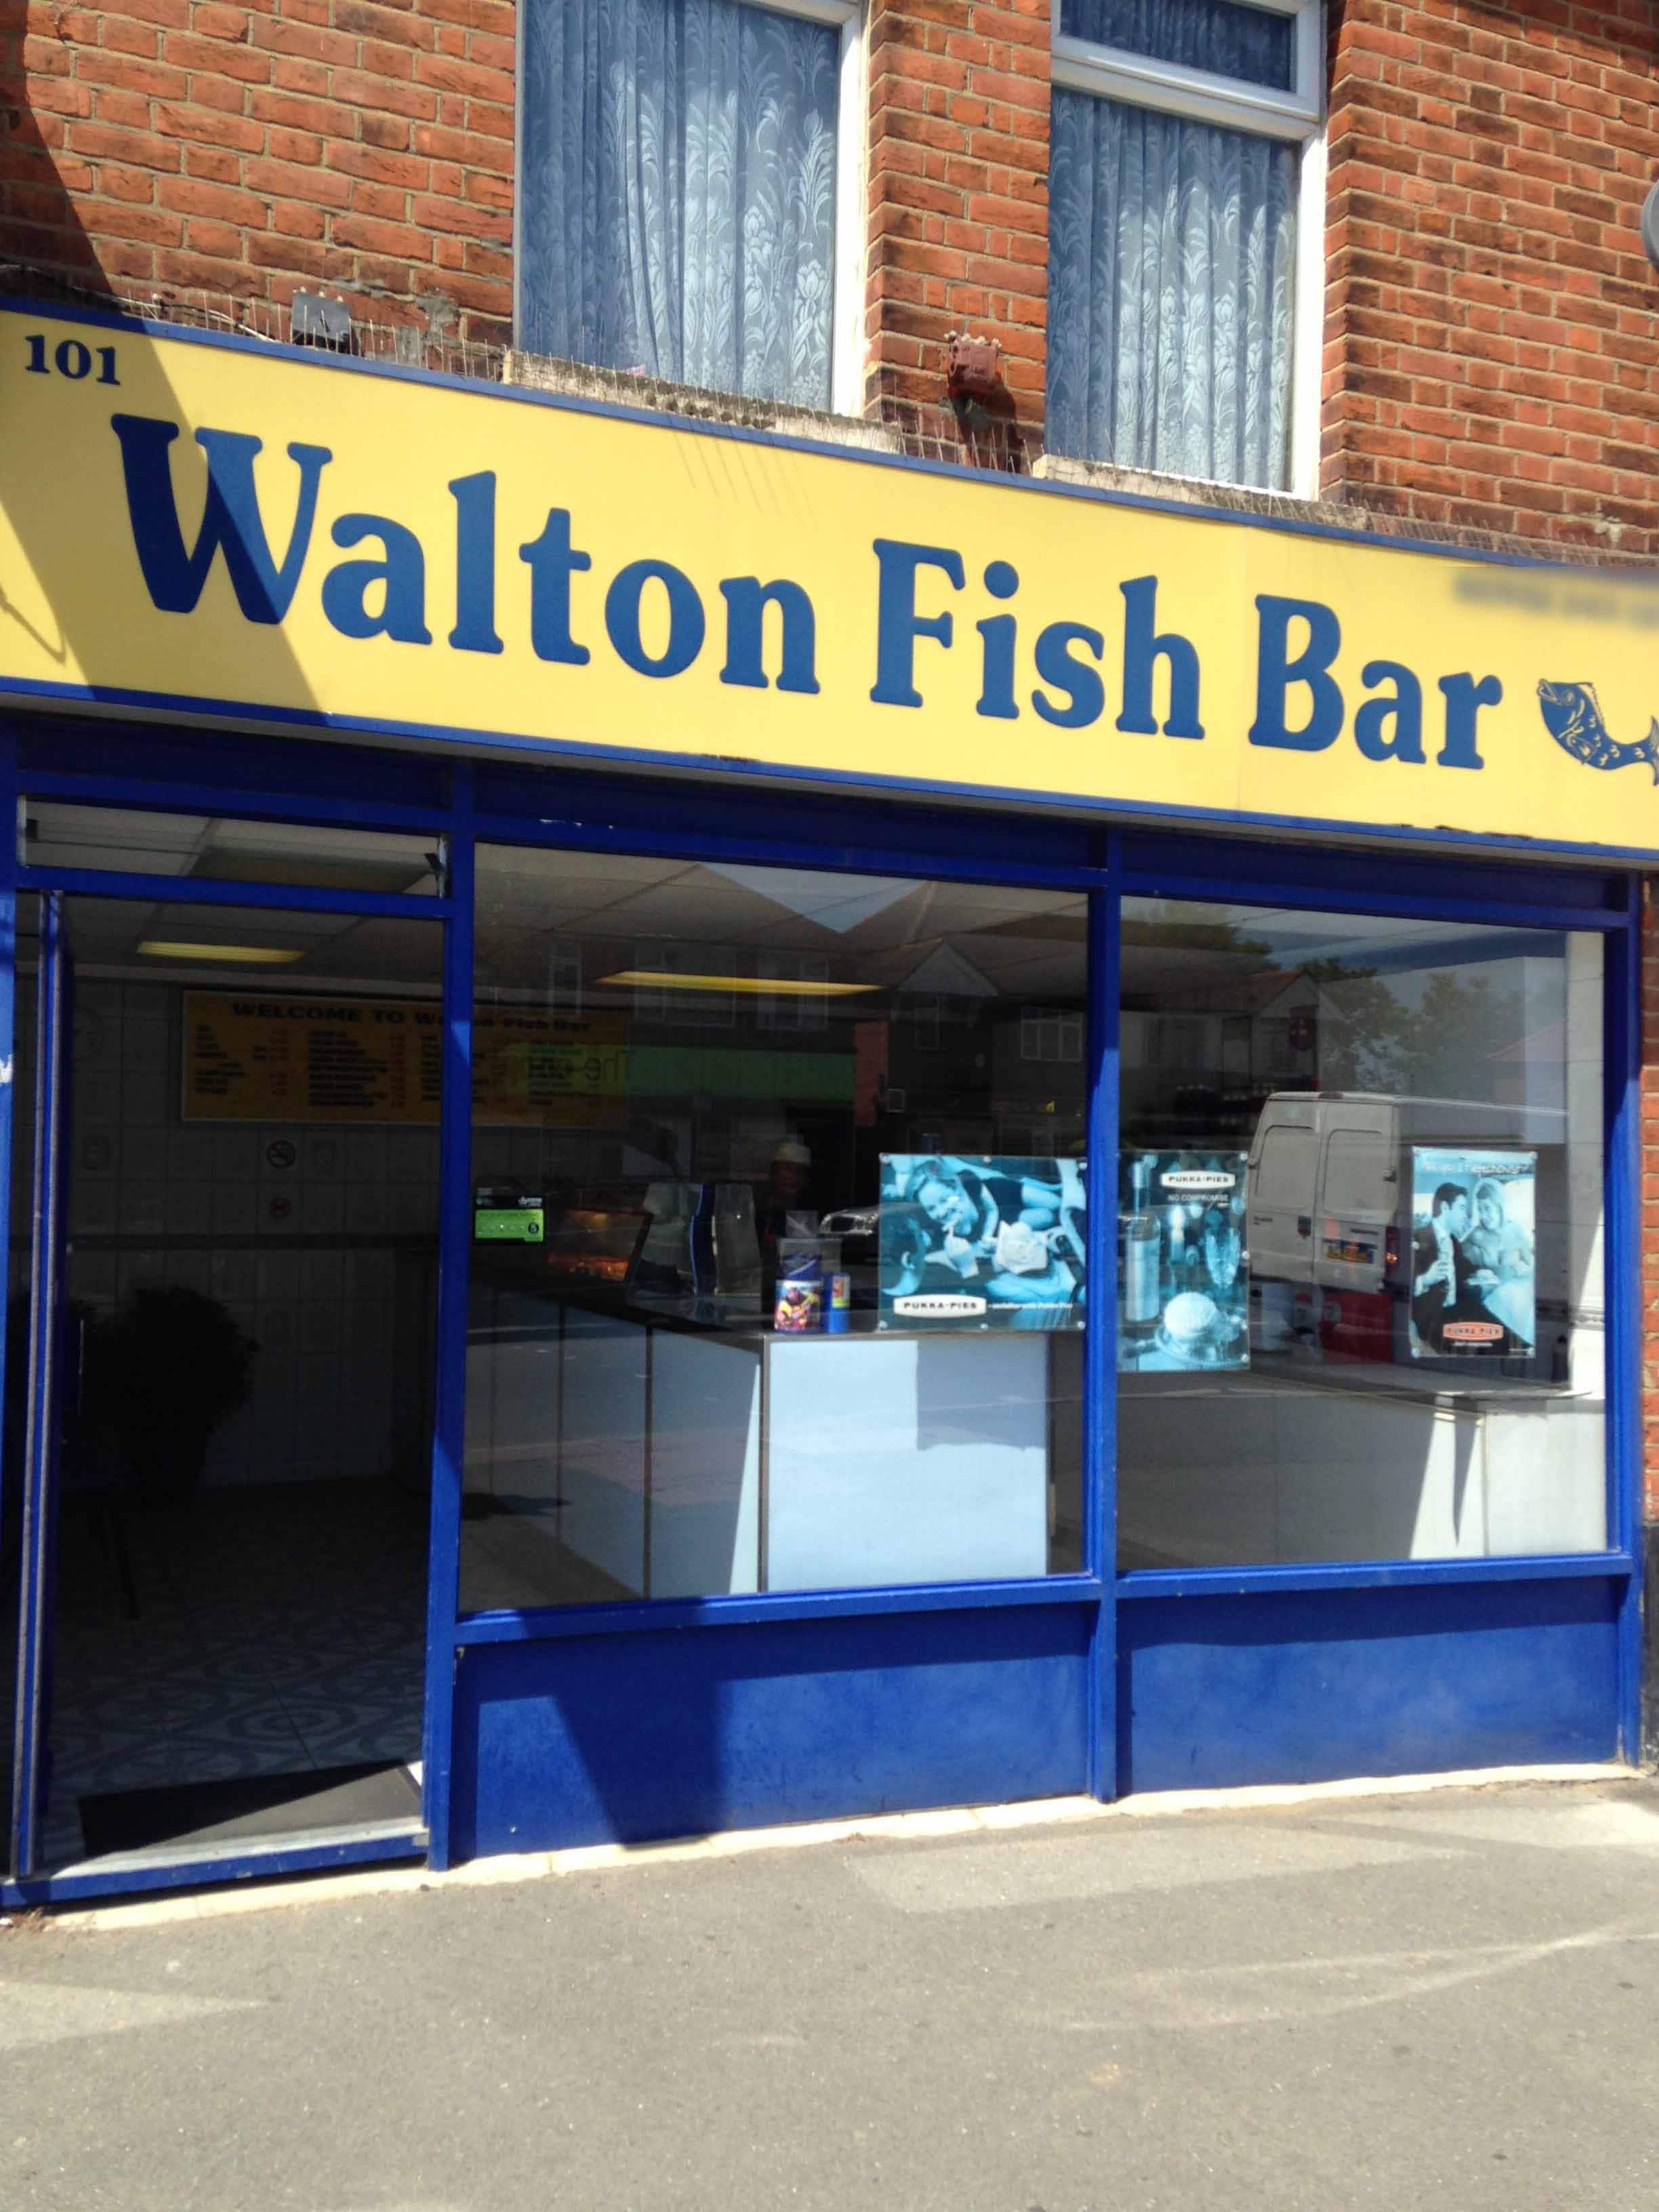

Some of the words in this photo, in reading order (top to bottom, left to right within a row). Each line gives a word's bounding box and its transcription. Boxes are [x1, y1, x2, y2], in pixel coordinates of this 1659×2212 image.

[24, 334, 121, 386] 101
[110, 413, 821, 695] Walton
[871, 537, 1205, 739] Fish
[1248, 593, 1503, 770] Bar
[232, 1003, 364, 1022] WELCOME
[369, 1008, 406, 1024] TO
